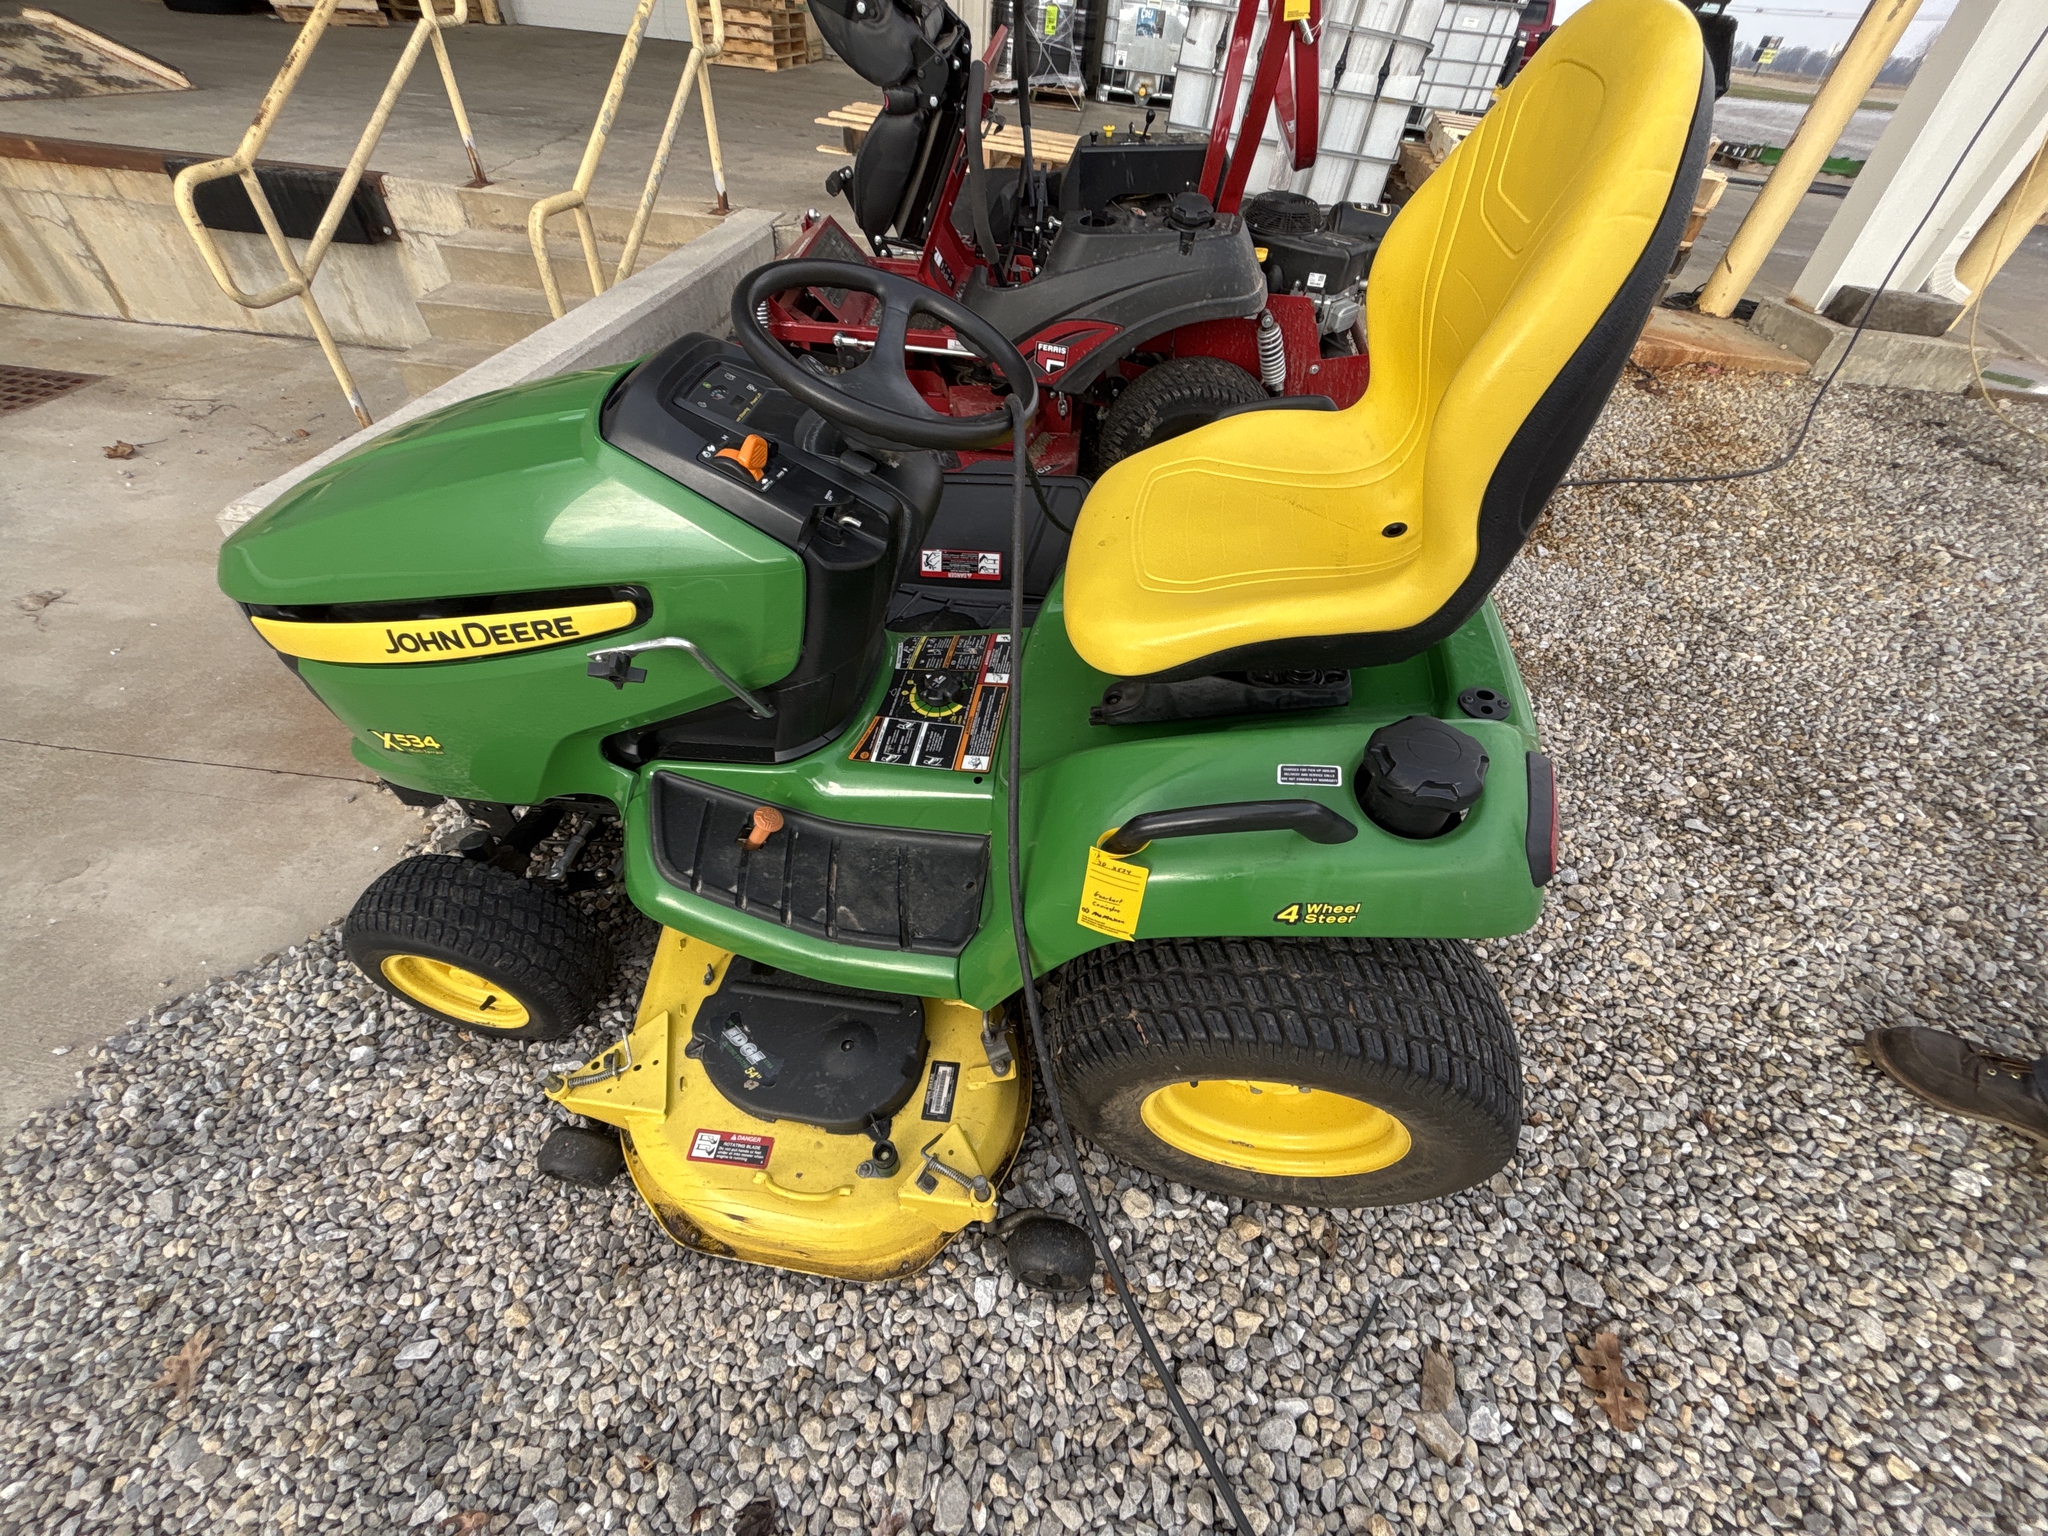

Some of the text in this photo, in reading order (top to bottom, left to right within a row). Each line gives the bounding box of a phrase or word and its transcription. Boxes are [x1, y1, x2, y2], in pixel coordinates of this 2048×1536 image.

[1038, 343, 1067, 354] FERRIS
[385, 616, 581, 654] JOHN DEERE
[371, 731, 441, 752] X534
[1275, 903, 1361, 924] 4 Wheel
[1303, 913, 1357, 924] Steer
[722, 1024, 767, 1065] EDGE
[737, 1135, 762, 1143] DANGER
